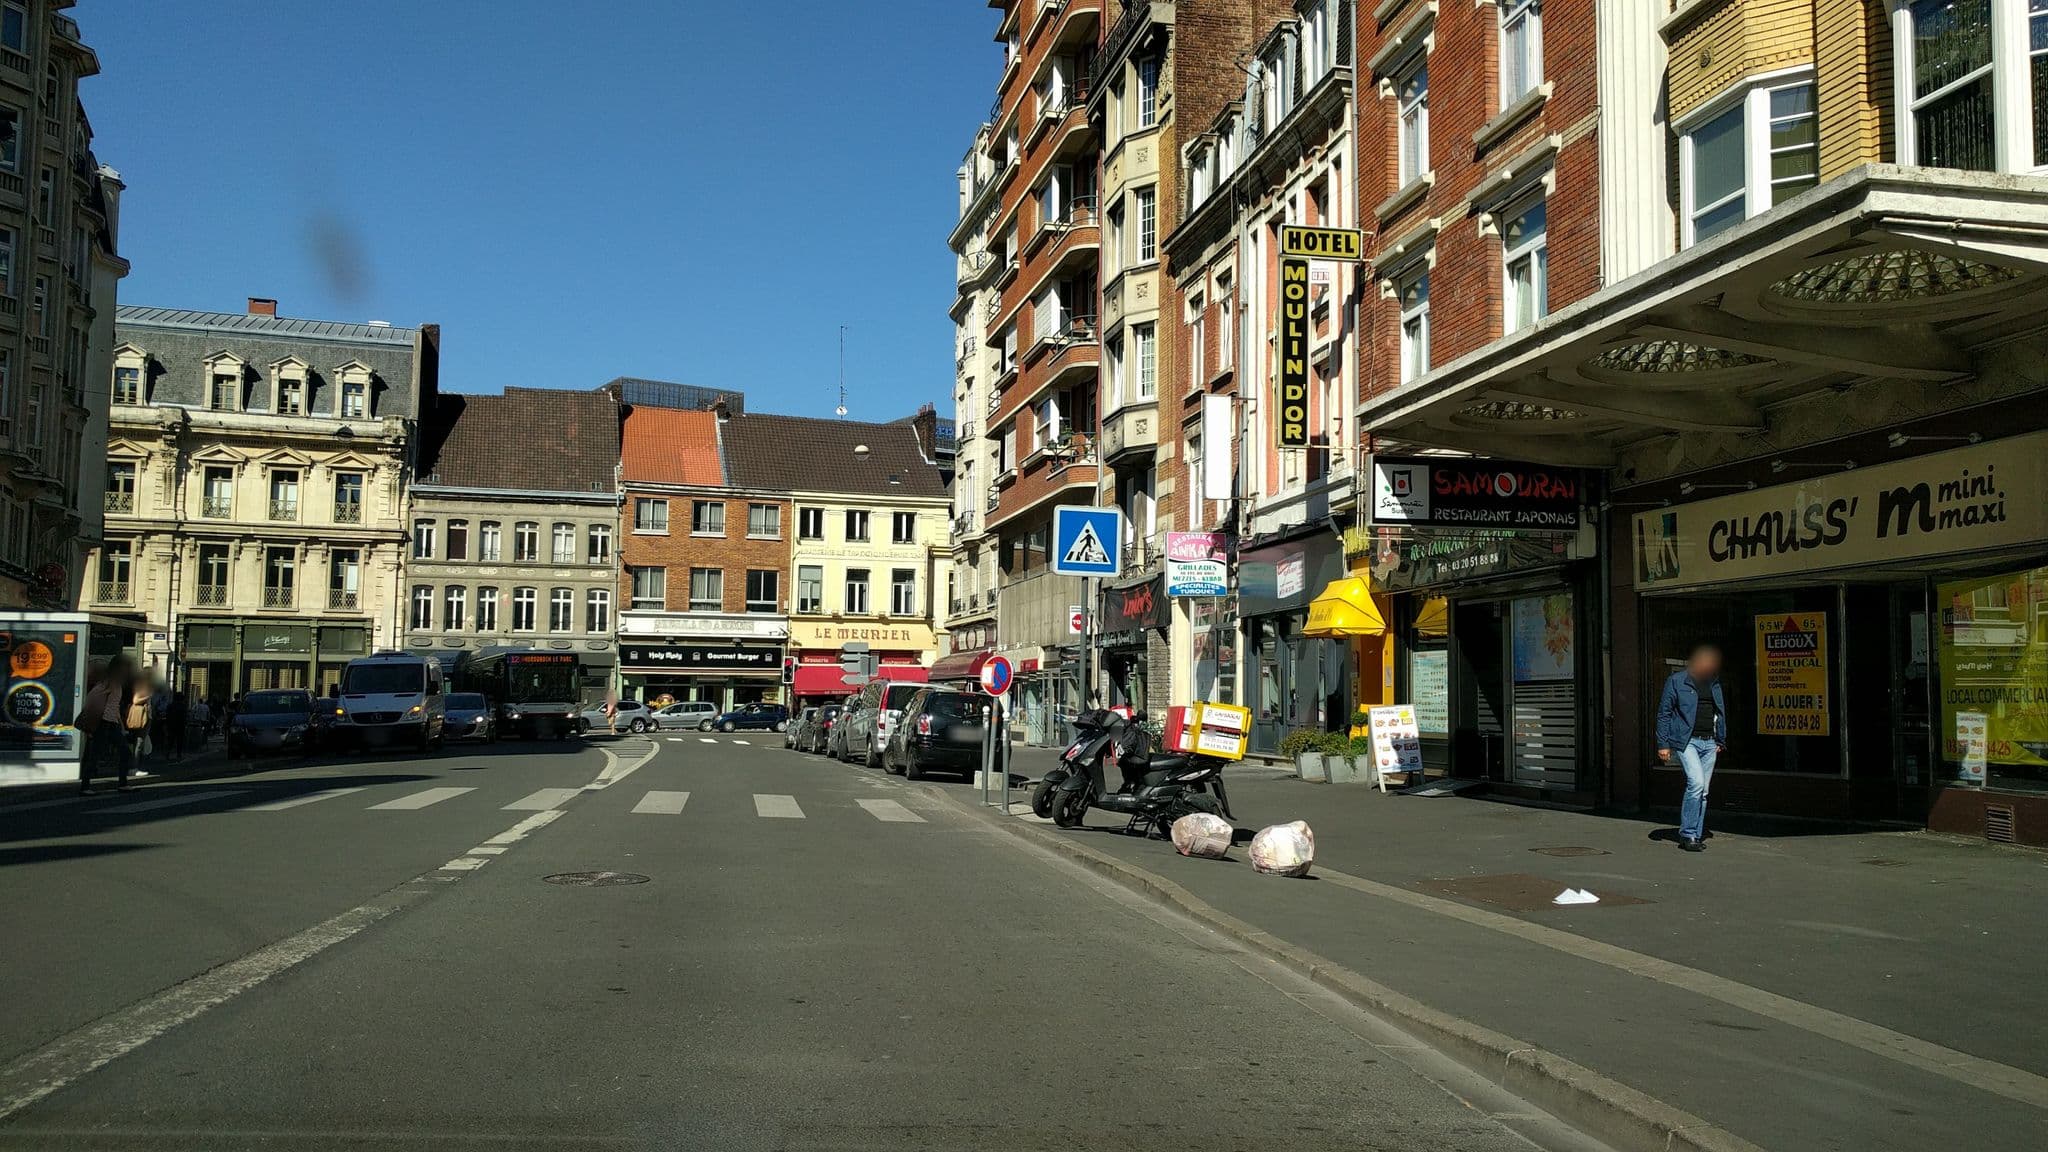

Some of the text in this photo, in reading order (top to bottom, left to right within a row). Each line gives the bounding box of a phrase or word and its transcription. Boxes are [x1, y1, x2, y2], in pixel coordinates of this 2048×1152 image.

[1287, 231, 1354, 253] HOTEL
[1284, 265, 1306, 440] MOULIN D'OR
[1434, 470, 1575, 498] SAMOURAI
[1937, 465, 1995, 503] mini
[1434, 508, 1576, 525] RESTAURANT JAPONAIS
[1938, 491, 2006, 530] maxi
[1708, 482, 1935, 562] CHAUSS' m
[1452, 561, 1460, 571] 03
[1461, 559, 1469, 569] 20
[1470, 557, 1478, 567] 51
[815, 628, 911, 640] LE MEUNIER
[1767, 633, 1816, 649] LEDOUX
[707, 652, 736, 660] Gourmet
[737, 652, 760, 661] Burger
[1786, 658, 1822, 667] LOCAL
[1778, 695, 1813, 709] LOUER
[1946, 688, 1976, 704] LOCAL
[1776, 714, 1785, 730] 20
[1787, 714, 1797, 730] 29
[1798, 714, 1808, 730] 84
[1809, 714, 1820, 730] 28
